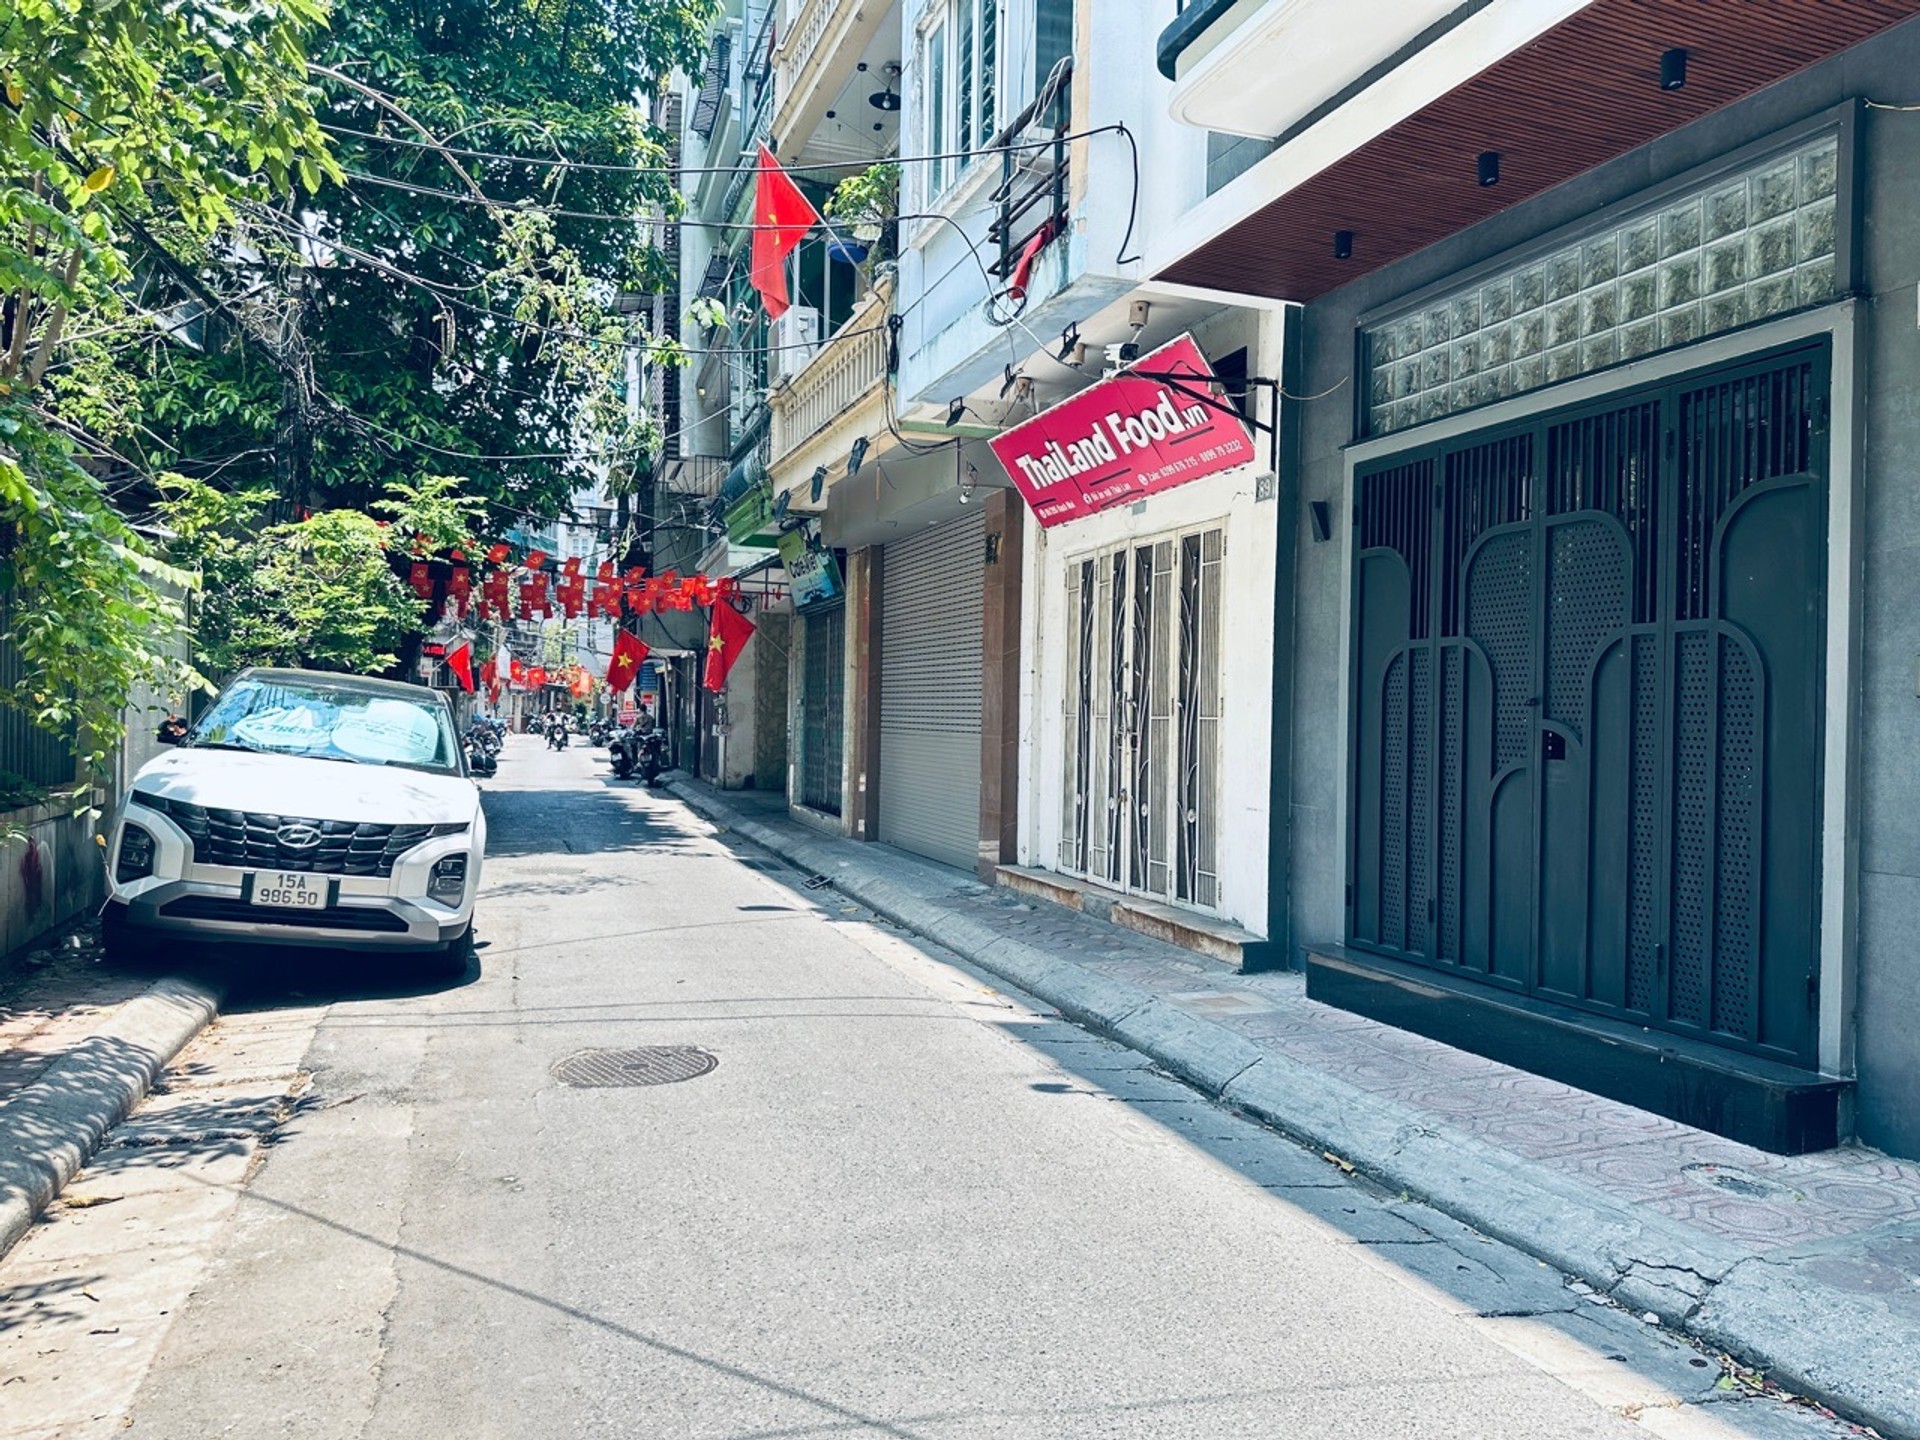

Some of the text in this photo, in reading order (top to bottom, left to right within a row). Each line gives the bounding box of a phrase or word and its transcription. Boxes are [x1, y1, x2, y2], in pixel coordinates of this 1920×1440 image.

[1015, 390, 1209, 490] ThaiLand Food.vn
[1259, 479, 1270, 498] 89
[278, 874, 306, 889] 15A
[260, 888, 318, 906] 986.50
